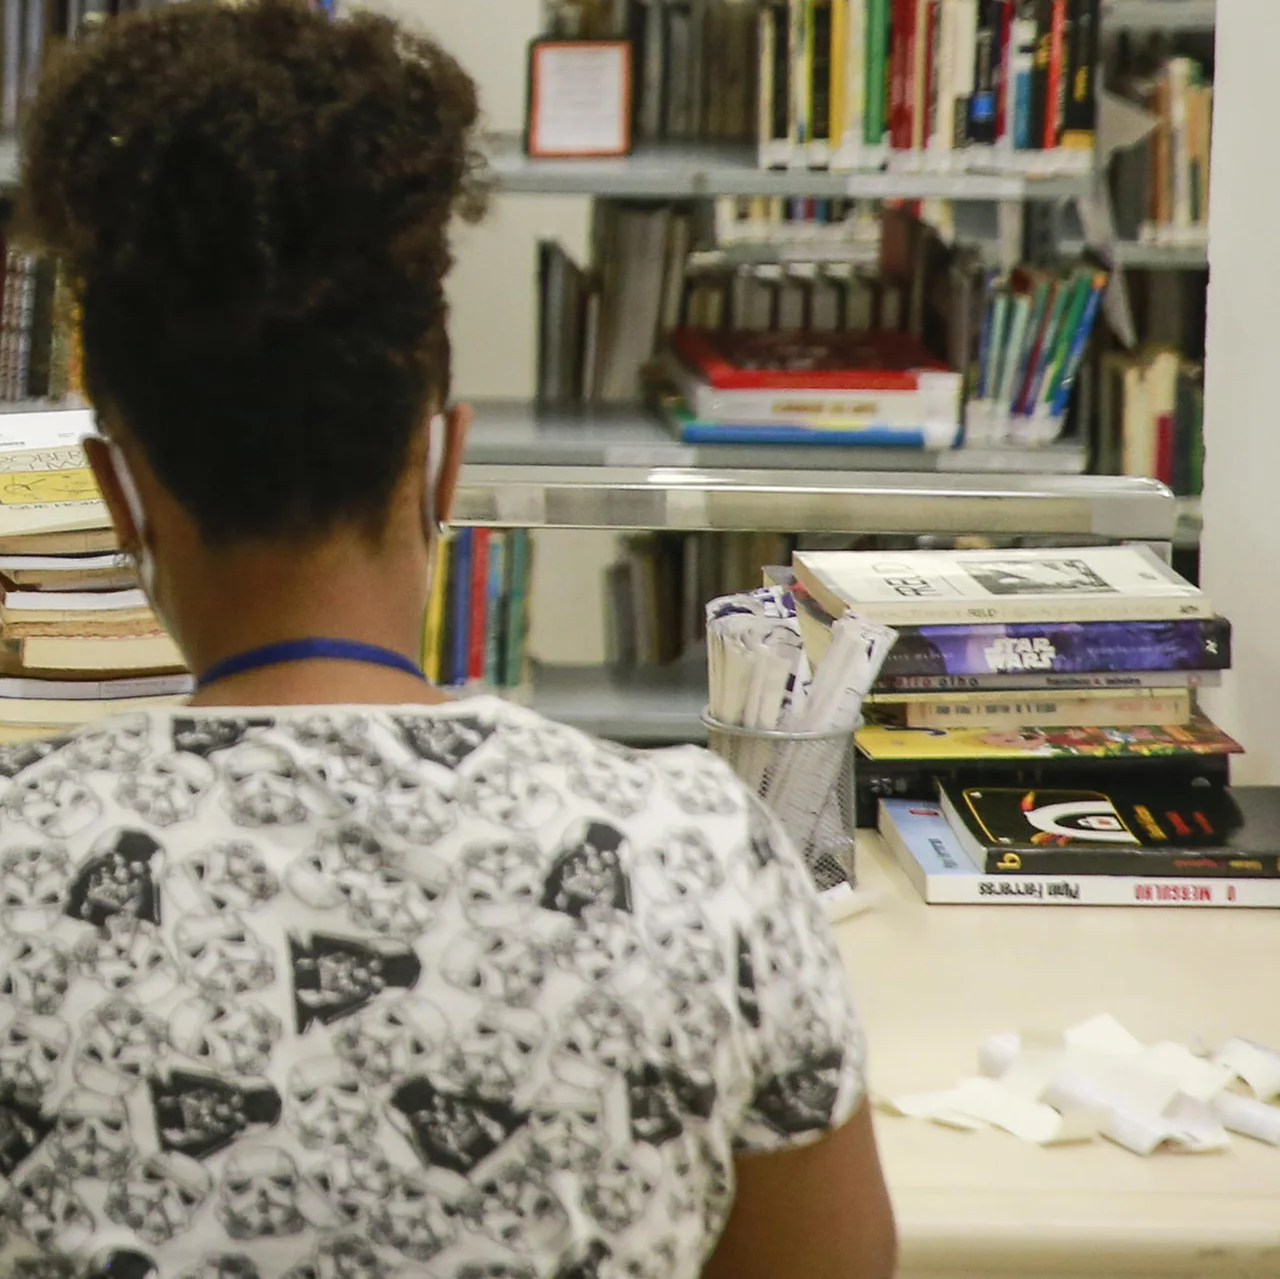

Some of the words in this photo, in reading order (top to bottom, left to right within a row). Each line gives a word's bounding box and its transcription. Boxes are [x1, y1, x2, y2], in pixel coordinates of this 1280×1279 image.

[991, 636, 1053, 654] STAR
[984, 650, 1057, 671] WARS
[1134, 884, 1213, 903] MERGULHO
